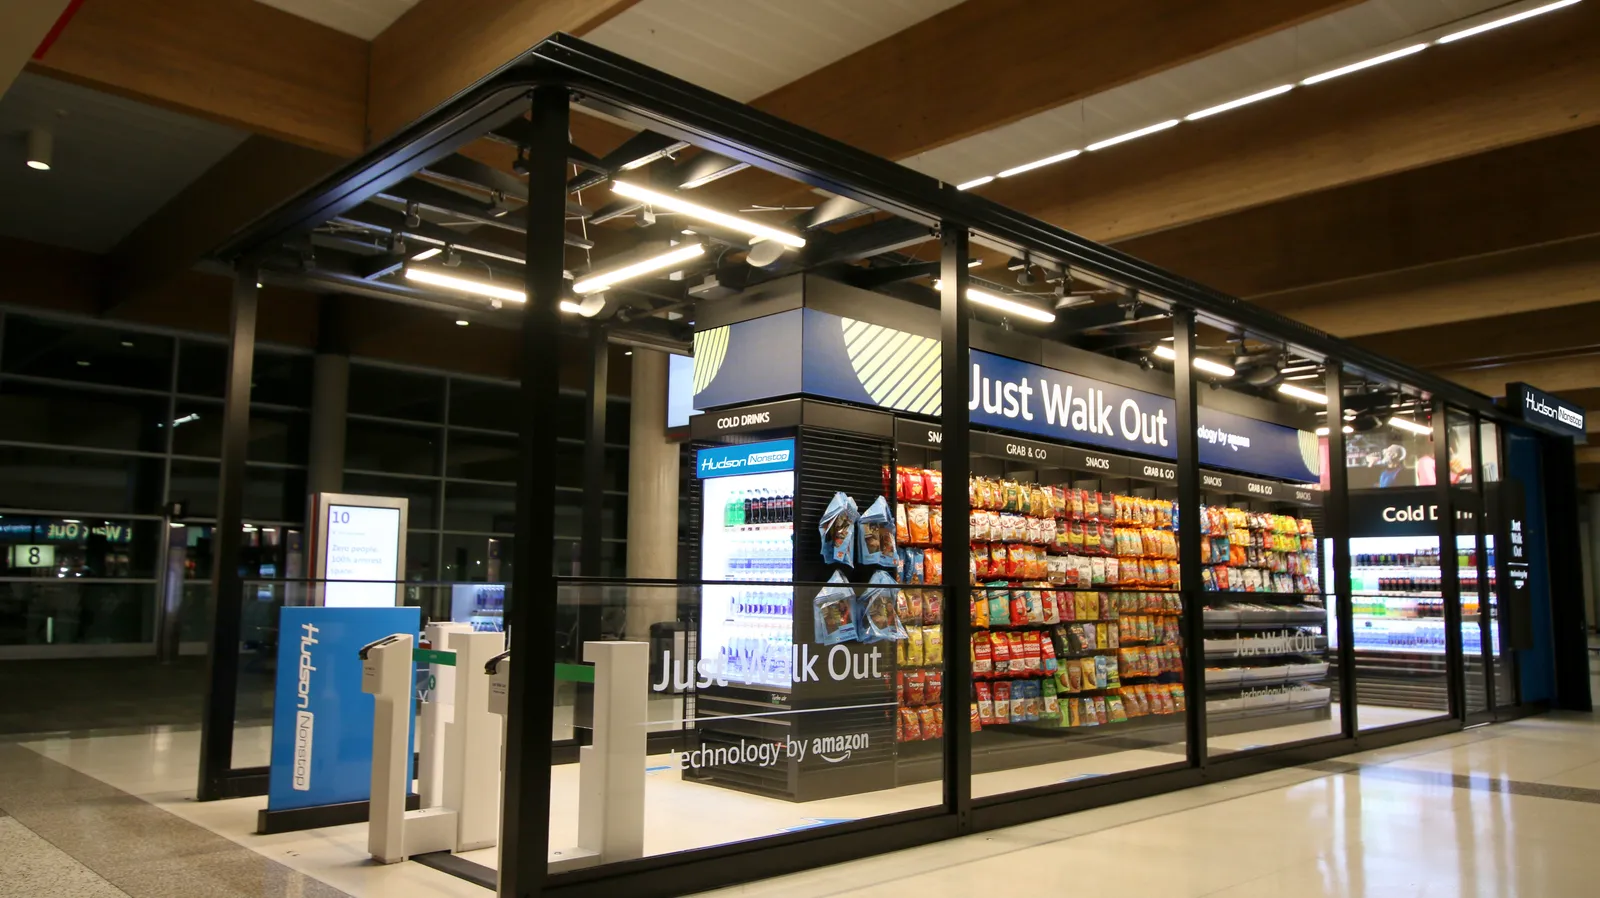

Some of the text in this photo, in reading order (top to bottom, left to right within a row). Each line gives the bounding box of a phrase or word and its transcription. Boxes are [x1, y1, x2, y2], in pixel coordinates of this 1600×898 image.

[968, 363, 1169, 447] Just Walk Out
[1525, 391, 1583, 428] Hudson Nonstop
[716, 411, 770, 429] COLD DRINKS
[1197, 425, 1218, 444] ology
[1218, 428, 1228, 446] by
[1006, 443, 1026, 455] GRAB
[1034, 448, 1047, 460] GO
[701, 453, 789, 471] Hudson Nonstop
[1085, 456, 1110, 470] SNACKS
[1143, 465, 1175, 480] GRAB & GO
[1203, 475, 1222, 487] SNACKS
[1248, 482, 1273, 495] GRAB & GO
[332, 511, 350, 524] 10
[1382, 504, 1424, 523] Cold
[28, 546, 41, 565] 8
[1233, 629, 1317, 657] Just Walk Out
[297, 622, 320, 709] Hudson
[653, 643, 882, 692] Just Walk Out
[295, 714, 311, 787] Nonstop
[670, 732, 869, 771] technology by amazon
